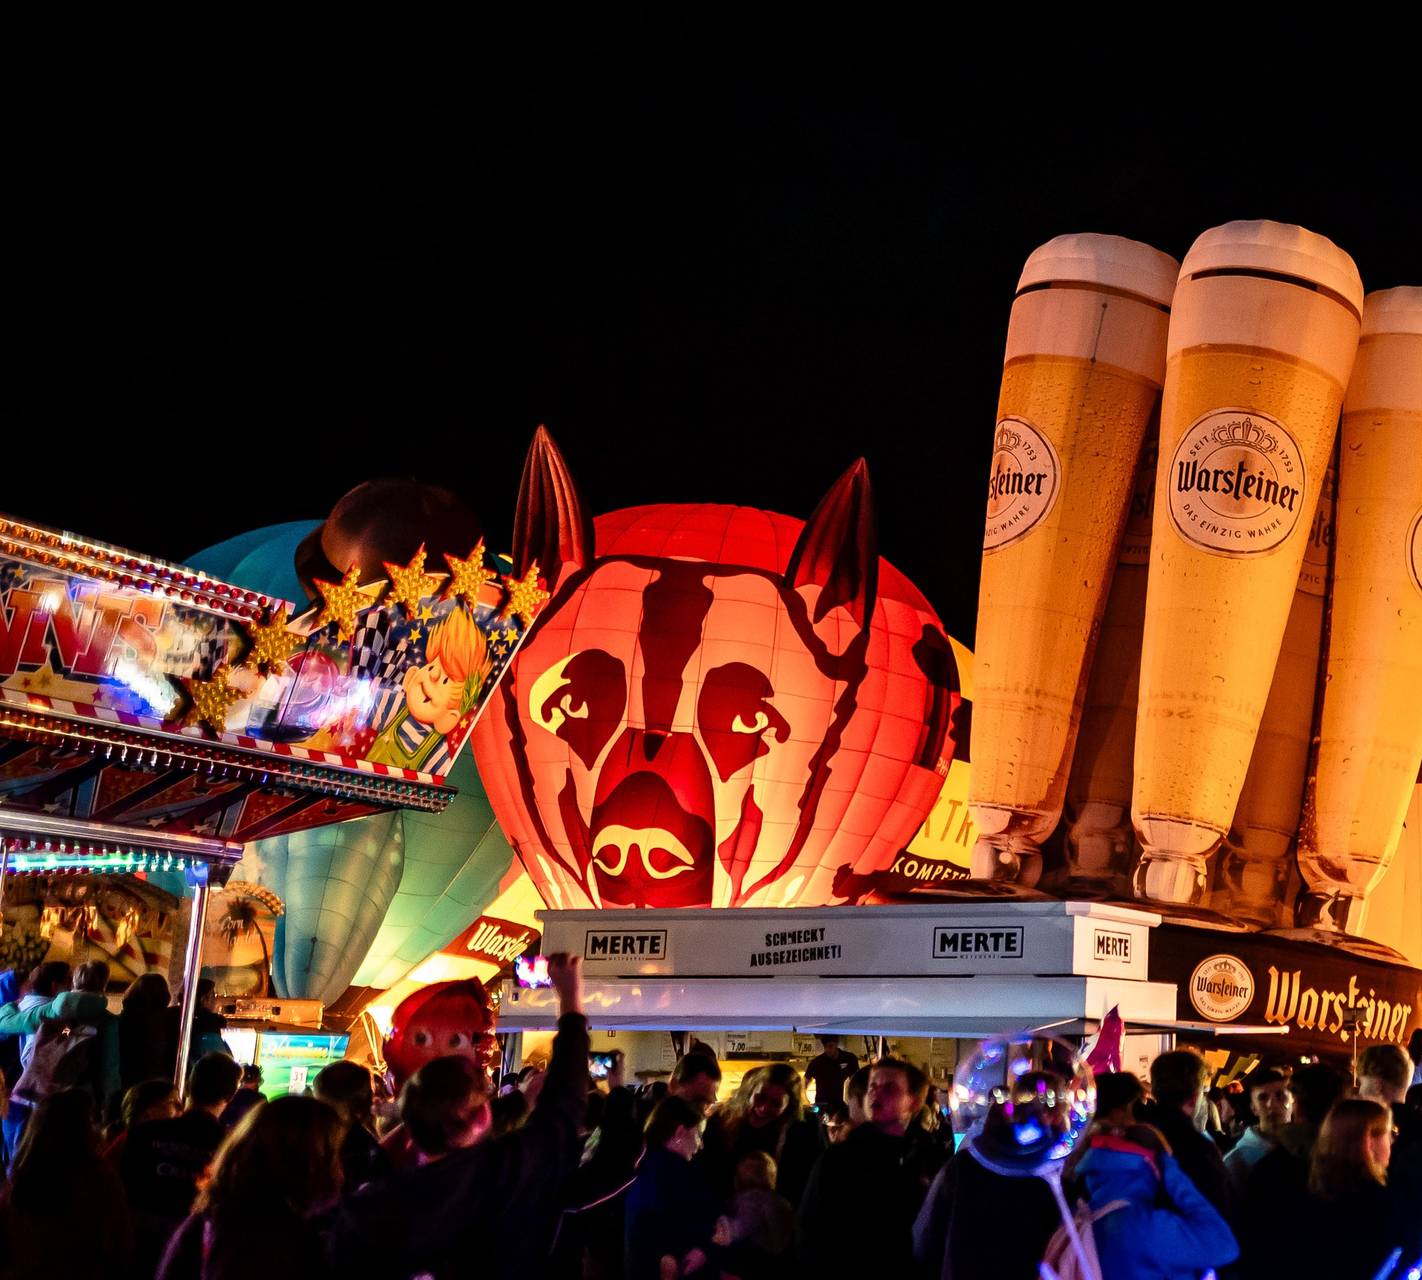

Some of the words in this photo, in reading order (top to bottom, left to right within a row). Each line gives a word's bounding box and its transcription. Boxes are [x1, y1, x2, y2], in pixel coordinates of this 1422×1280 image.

[1022, 441, 1037, 461] 1753
[1190, 435, 1212, 457] SEIT
[1279, 449, 1293, 473] 1753
[1177, 459, 1299, 512] Warsteiner
[1001, 504, 1030, 527] WAHRE
[1183, 503, 1198, 522] DAS
[1200, 520, 1242, 539] EINZIG
[1247, 518, 1282, 539] WAHRE
[590, 935, 661, 954] MERTE
[765, 927, 825, 947] SCHMECKT
[939, 932, 1017, 952] MERTE
[1097, 935, 1129, 957] MERTE
[750, 944, 842, 968] AUSGEZEICHNET!
[1196, 975, 1249, 999] Warsteiner
